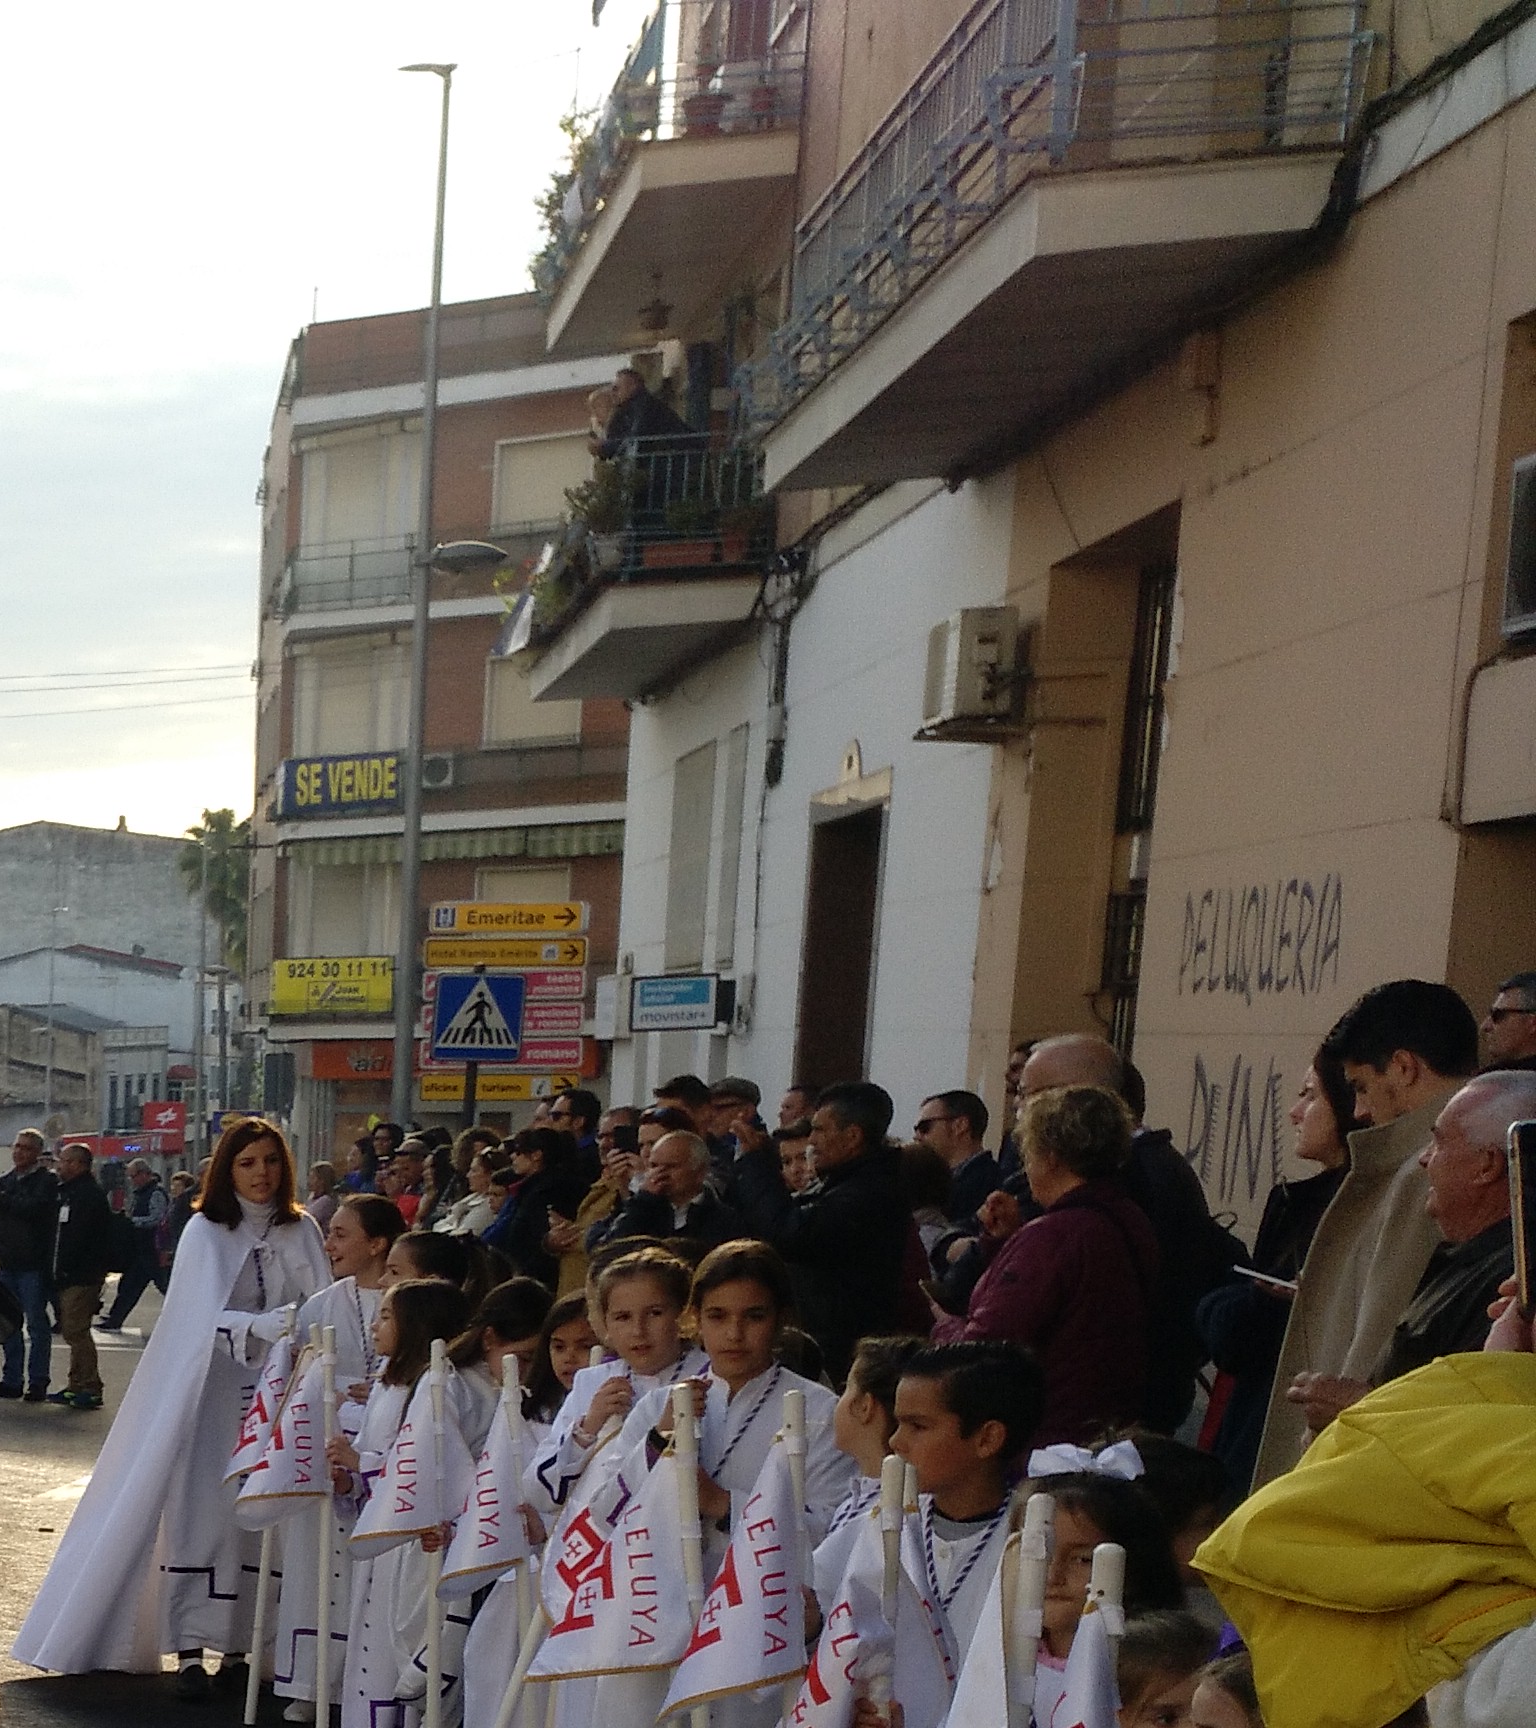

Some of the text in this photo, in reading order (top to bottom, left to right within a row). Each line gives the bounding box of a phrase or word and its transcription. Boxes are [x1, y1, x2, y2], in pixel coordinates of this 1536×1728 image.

[295, 757, 397, 806] SE VENDE
[466, 910, 546, 925] Emeritae
[288, 962, 388, 978] 924 30 11 11
